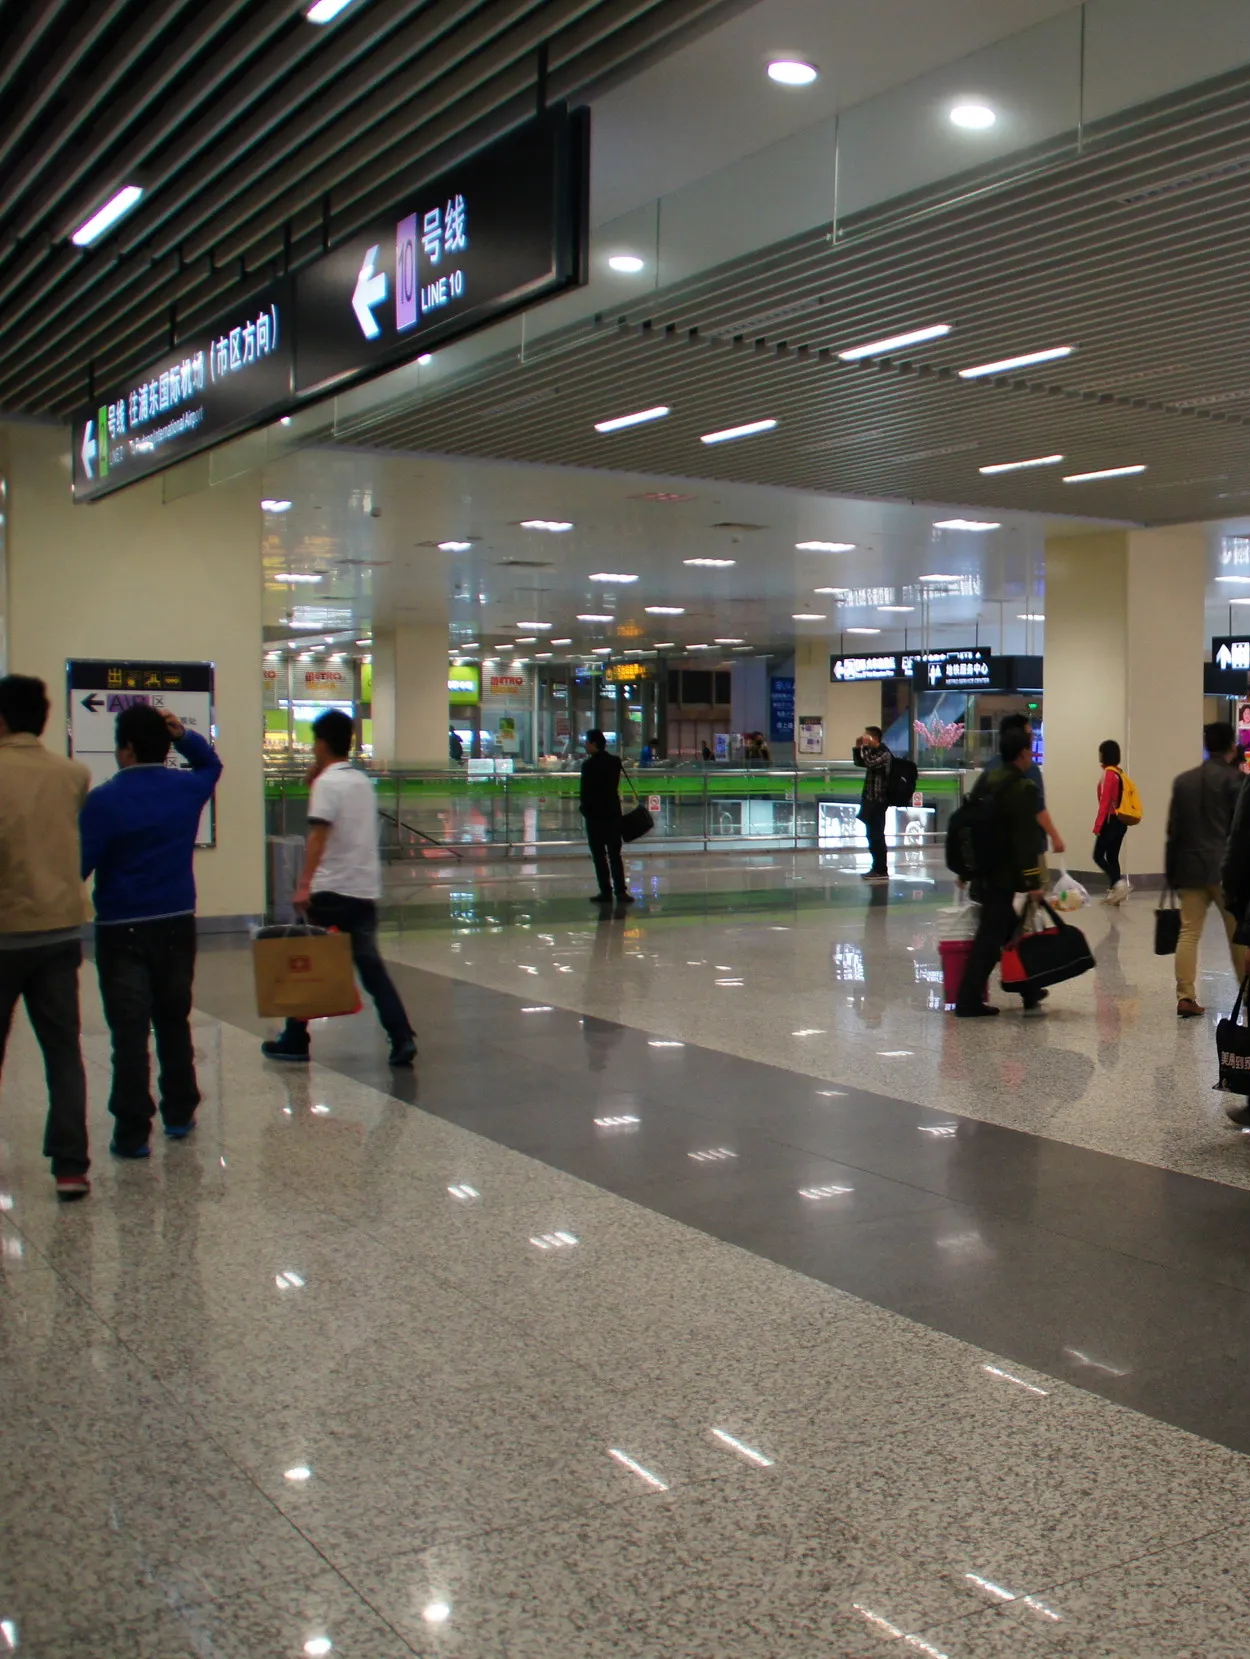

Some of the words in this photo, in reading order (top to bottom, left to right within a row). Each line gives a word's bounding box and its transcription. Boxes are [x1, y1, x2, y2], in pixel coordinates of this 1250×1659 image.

[397, 238, 415, 305] 10
[421, 194, 466, 263] 号线
[421, 277, 448, 312] LINE
[449, 269, 463, 297] 10
[108, 398, 126, 439] 号线
[129, 351, 204, 427] 往浦东国际机场
[210, 303, 277, 384] (市区方向)
